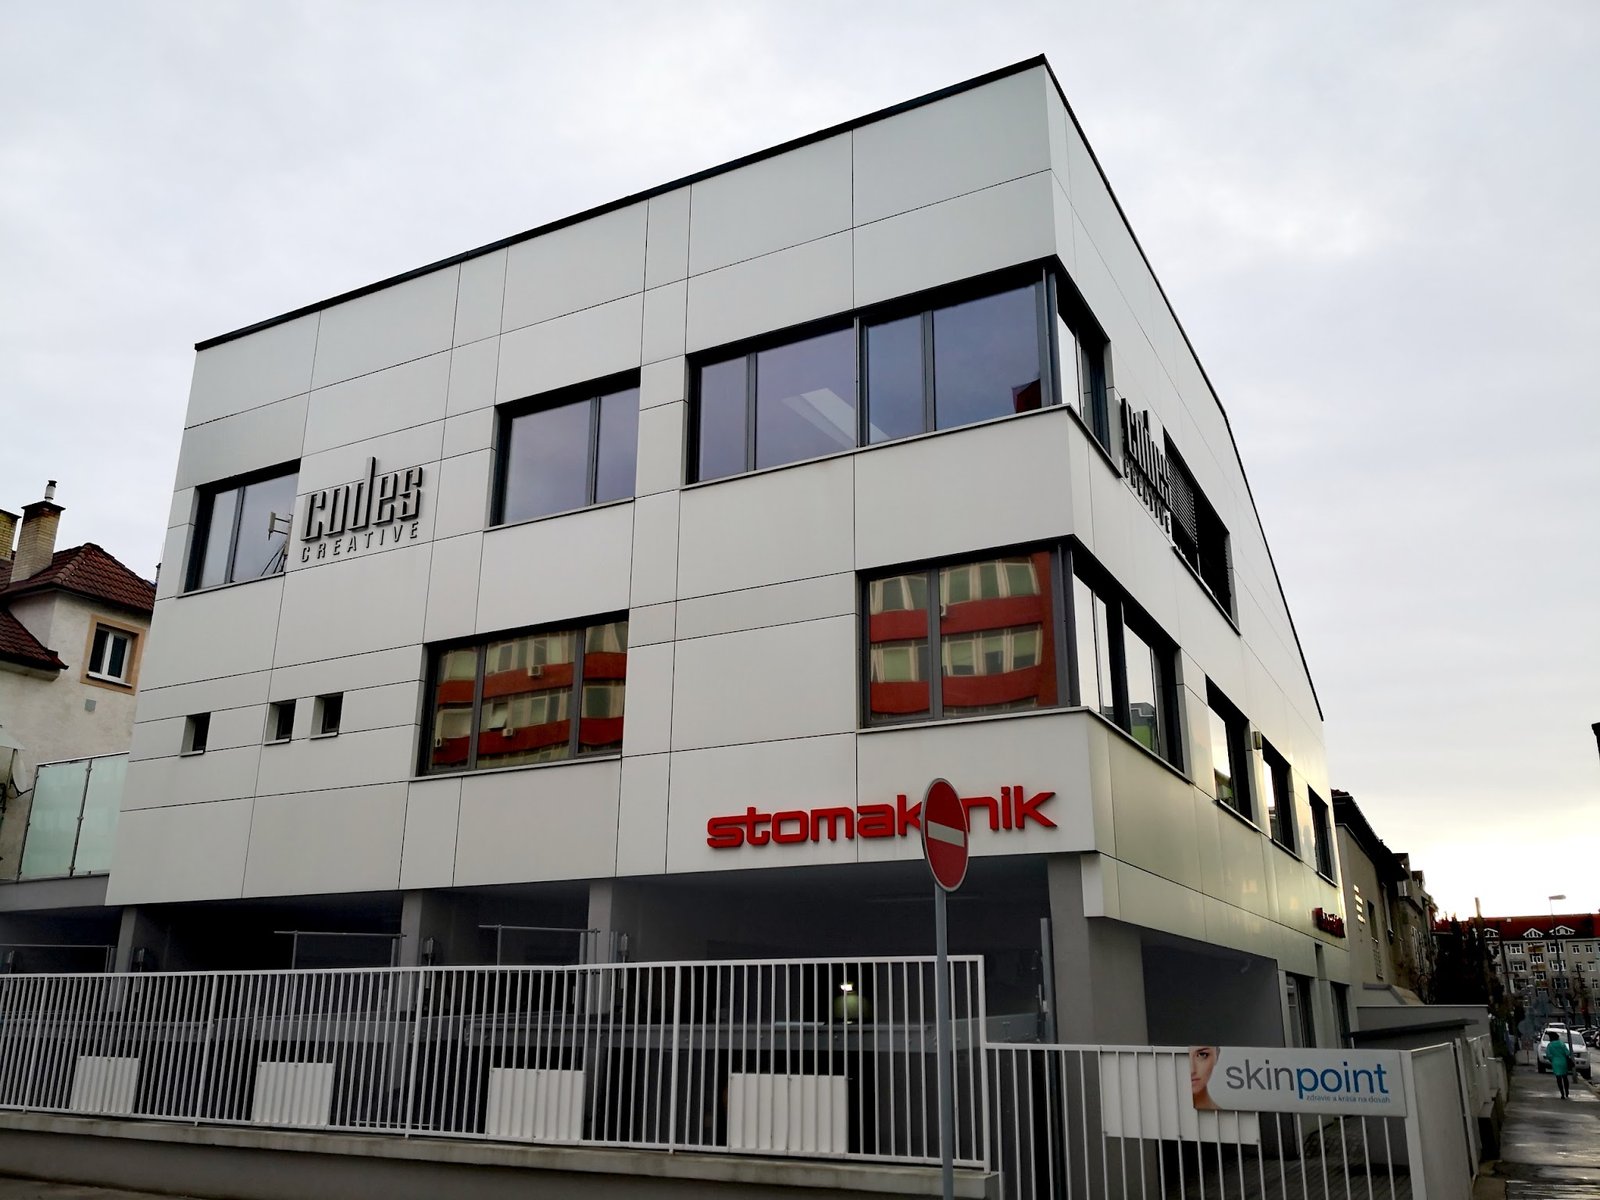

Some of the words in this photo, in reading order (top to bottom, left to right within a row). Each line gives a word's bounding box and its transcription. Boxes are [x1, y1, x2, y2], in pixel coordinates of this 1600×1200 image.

[300, 456, 423, 541] codes
[302, 521, 419, 562] CREATIVE
[706, 785, 1058, 849] stomaknik
[1225, 1059, 1389, 1099] skinpoint
